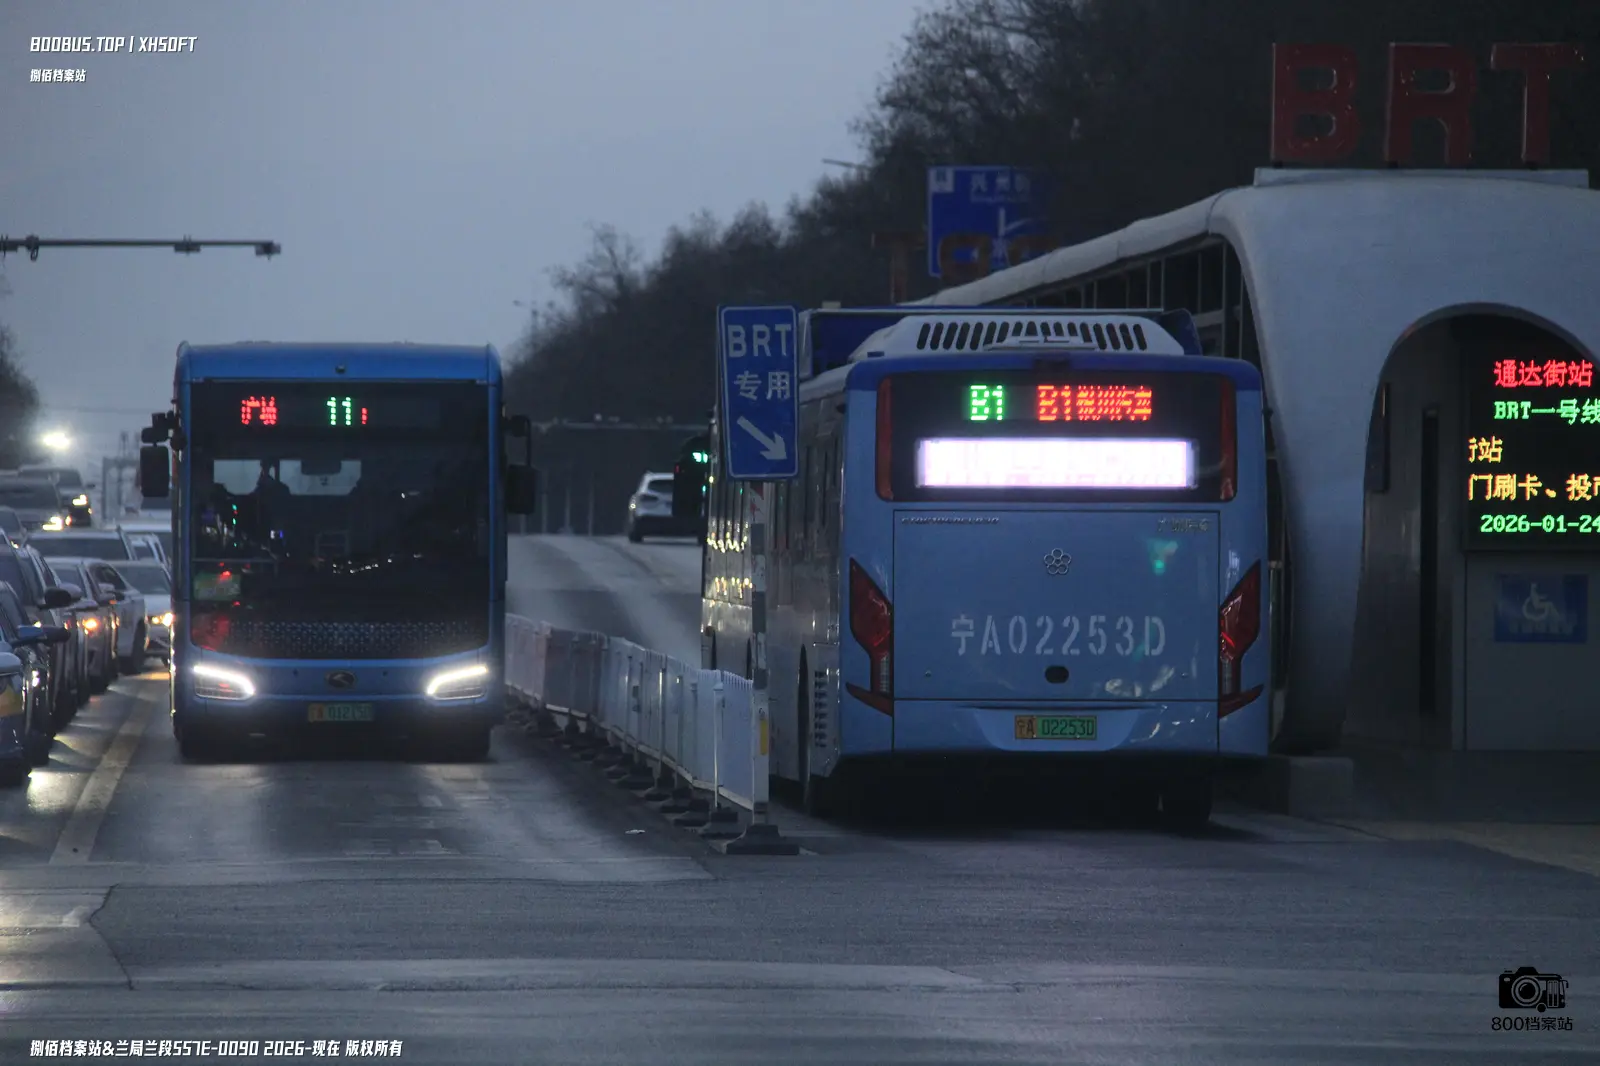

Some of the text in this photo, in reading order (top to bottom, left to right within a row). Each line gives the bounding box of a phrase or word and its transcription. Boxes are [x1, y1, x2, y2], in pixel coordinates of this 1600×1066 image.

[1270, 42, 1586, 163] BRT
[727, 323, 792, 358] BRT
[734, 370, 791, 400] 专用
[1493, 359, 1593, 388] 通达街站
[970, 384, 1005, 421] B1
[951, 614, 1166, 656] 宁A02253D
